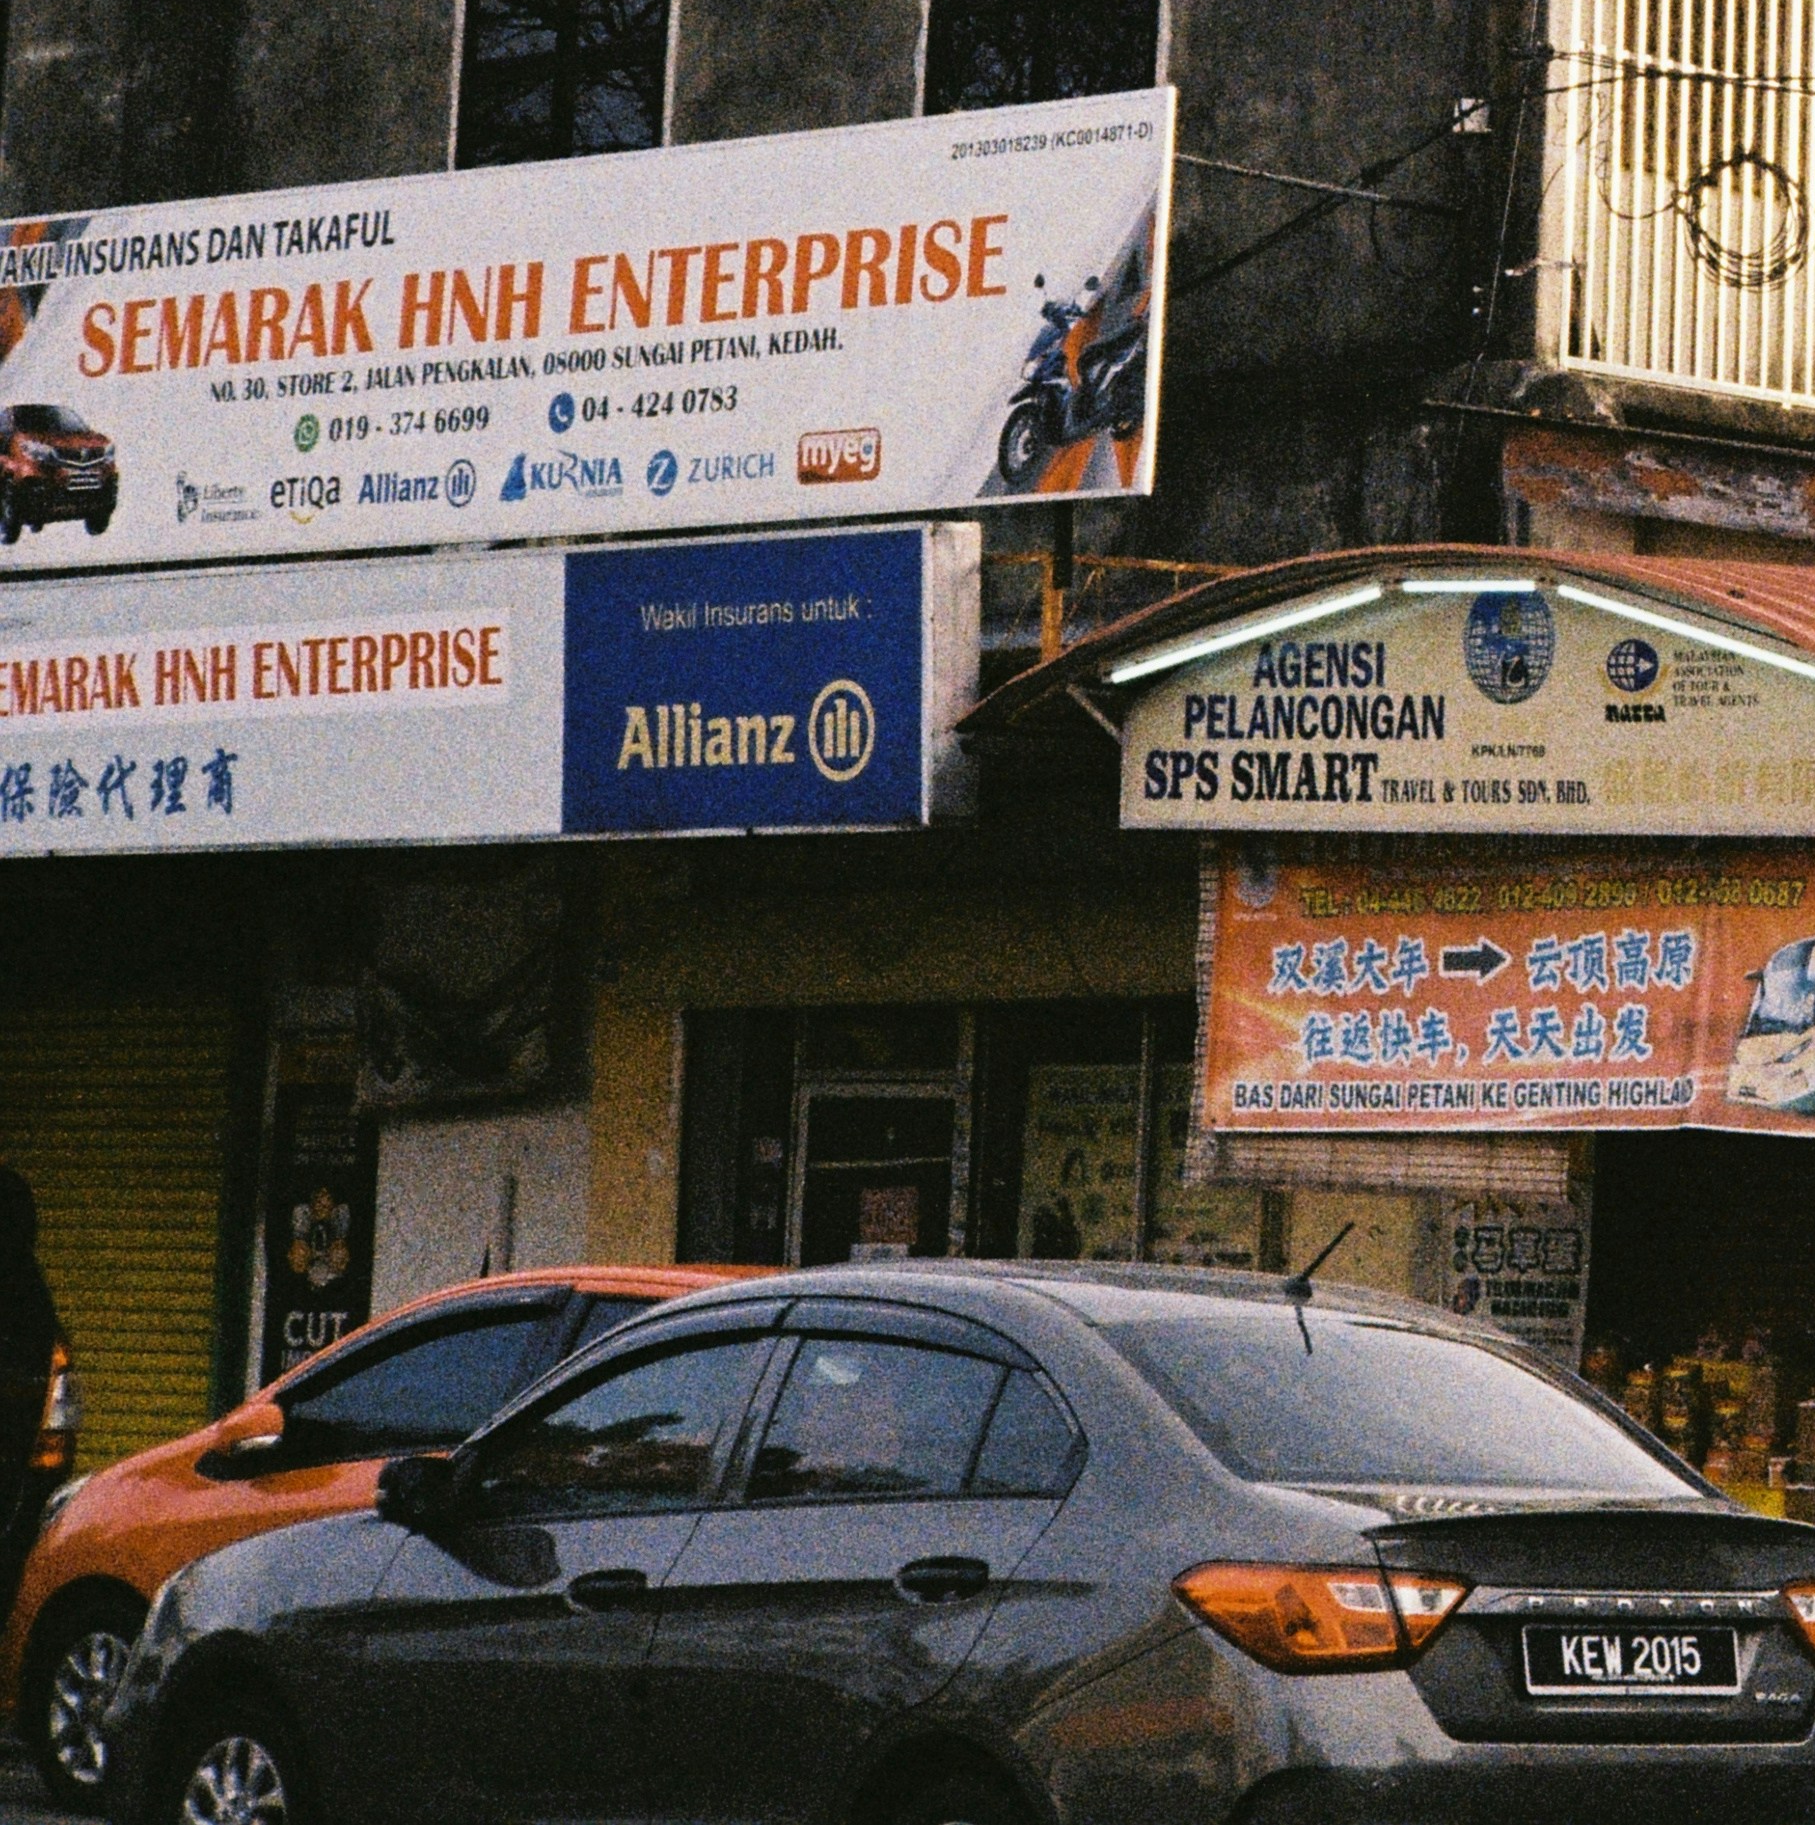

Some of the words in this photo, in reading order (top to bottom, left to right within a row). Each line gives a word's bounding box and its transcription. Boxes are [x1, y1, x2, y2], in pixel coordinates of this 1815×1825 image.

[65, 229, 200, 277] INSURANS
[206, 223, 266, 264] DAN
[273, 210, 395, 256] TAKAFUL
[79, 278, 374, 378] SEMARAK
[399, 261, 544, 349] HNH
[568, 215, 1008, 336] ENTERPRISE
[277, 371, 334, 397] STORE
[366, 364, 415, 391] JALAN
[543, 348, 606, 376] 08000
[611, 341, 684, 369] SUNGAI
[690, 335, 761, 363] PETANI,
[767, 327, 843, 356] KEDAH.
[328, 416, 369, 442] 019
[389, 411, 425, 436] 374
[434, 406, 490, 433] 6699
[582, 396, 610, 422] 04
[630, 391, 674, 418] 424
[681, 385, 738, 413] 0783
[358, 473, 439, 505] Allianz
[688, 453, 774, 484] ZURICH
[641, 603, 697, 631] Wakil
[704, 601, 793, 628] Insurans
[802, 594, 860, 622] untuk
[154, 645, 236, 707] HNH
[252, 627, 502, 700] ENTERPRISE
[1253, 641, 1386, 689] AGENSI
[617, 702, 796, 770] Allianz
[1184, 694, 1445, 741] PELANCONGAN
[1144, 749, 1219, 801] SPS
[1230, 749, 1378, 803] SMART
[1381, 779, 1436, 804] TRAVEL
[1443, 782, 1455, 804] &
[1462, 779, 1512, 804] TOURS
[1518, 779, 1551, 805] SDN.
[1556, 780, 1591, 805] BHD.
[1271, 940, 1428, 994] 双溪大年
[1526, 931, 1694, 992] 云顶高原
[1234, 1082, 1274, 1109] BAS
[1279, 1082, 1323, 1110] DARI
[1328, 1081, 1400, 1109] SUNGAI
[1407, 1080, 1474, 1109] PETANI
[1481, 1080, 1506, 1109] KE
[1514, 1079, 1600, 1109] GENTING
[282, 1309, 349, 1348] CUT
[1561, 1635, 1622, 1676] KEW
[1631, 1635, 1701, 1676] 2015
